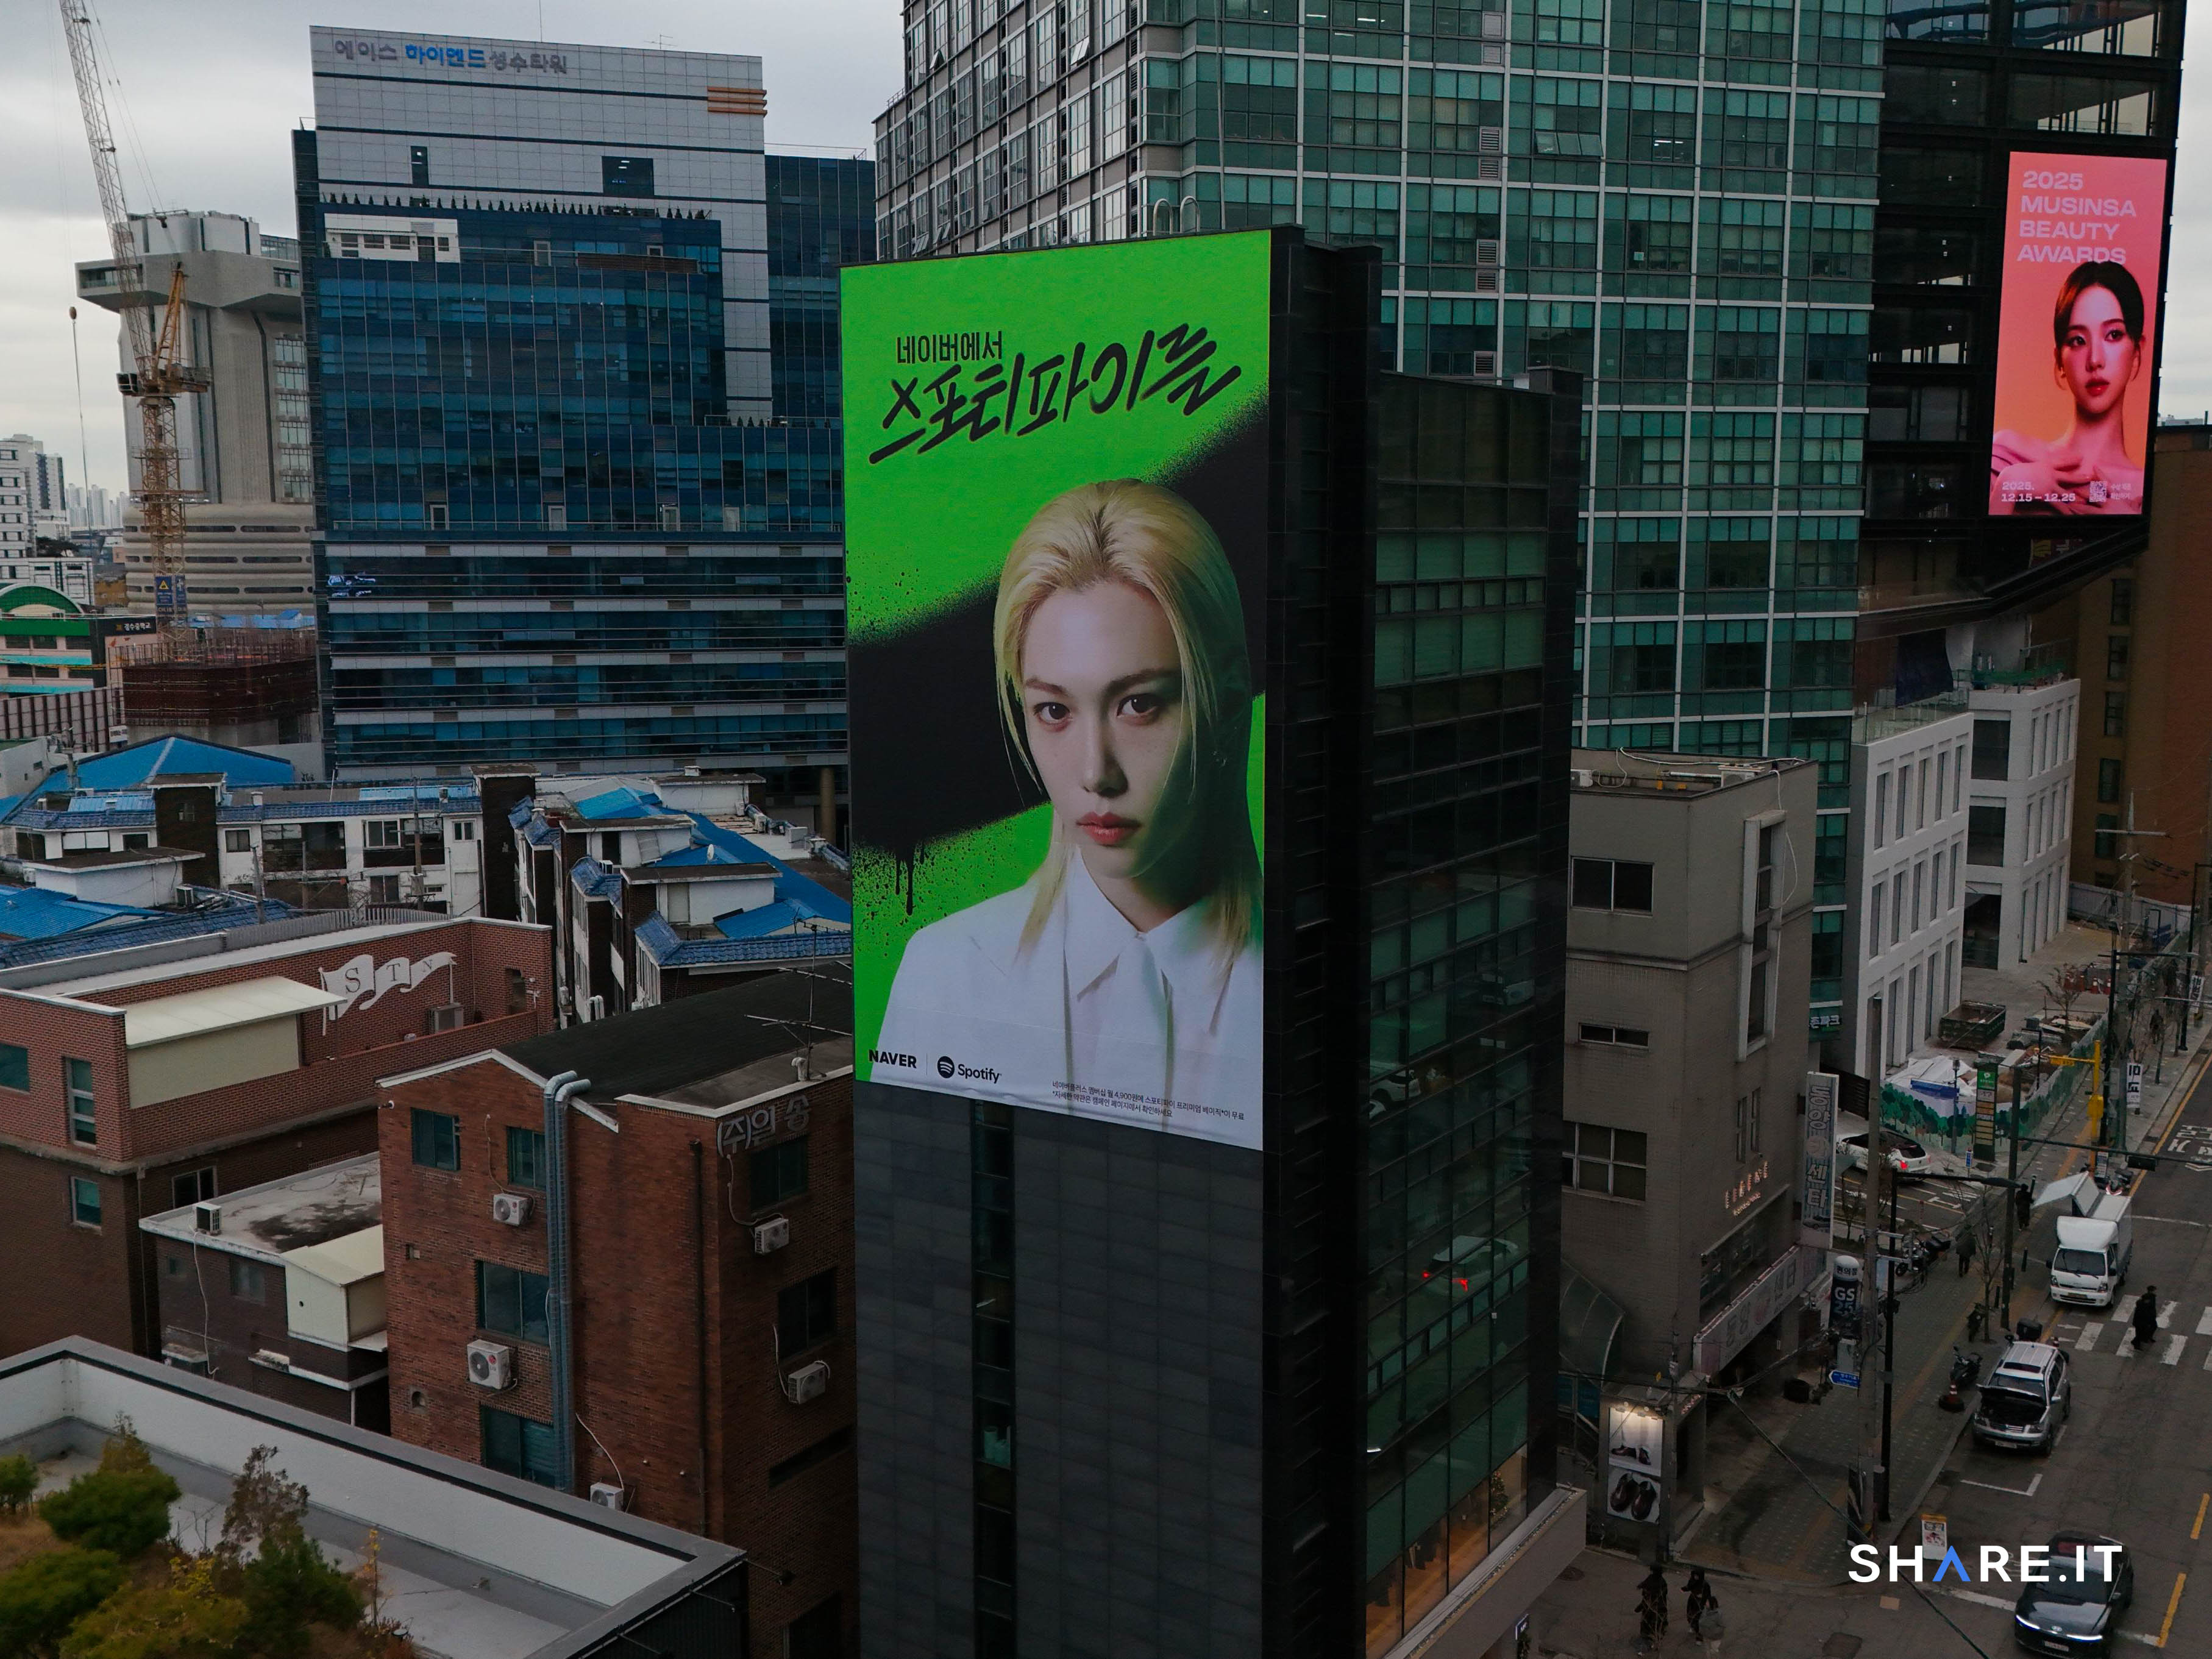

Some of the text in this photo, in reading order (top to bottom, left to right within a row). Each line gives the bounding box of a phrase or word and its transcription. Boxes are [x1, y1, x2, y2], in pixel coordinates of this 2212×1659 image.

[335, 40, 397, 61] 에이스
[2022, 171, 2083, 190] 2025
[2020, 195, 2136, 217] MUSINSA
[2019, 219, 2120, 240] BEAUTY
[2017, 244, 2126, 265] AWARDS
[897, 331, 1003, 364] 네이버에서
[869, 322, 1242, 464] 스포티파이를
[2002, 481, 2035, 490] 2025.
[2001, 492, 2033, 502] 12.15
[2044, 493, 2076, 502] 12.25
[868, 1049, 917, 1068] NAVER
[958, 1064, 1000, 1084] Spotify
[1052, 1081, 1087, 1093] 네이버플러스
[1088, 1087, 1106, 1096] 멤버십
[1114, 1092, 1143, 1103] 4,900원에
[1145, 1096, 1175, 1109] 스포티파이
[1176, 1101, 1201, 1114] 프리미엄
[1231, 1111, 1245, 1120] 무료
[1092, 1097, 1109, 1107] 캠페인
[1111, 1100, 1140, 1112] 페이지에서
[1142, 1105, 1173, 1117] 확인하세요
[1833, 1287, 1855, 1302] GS
